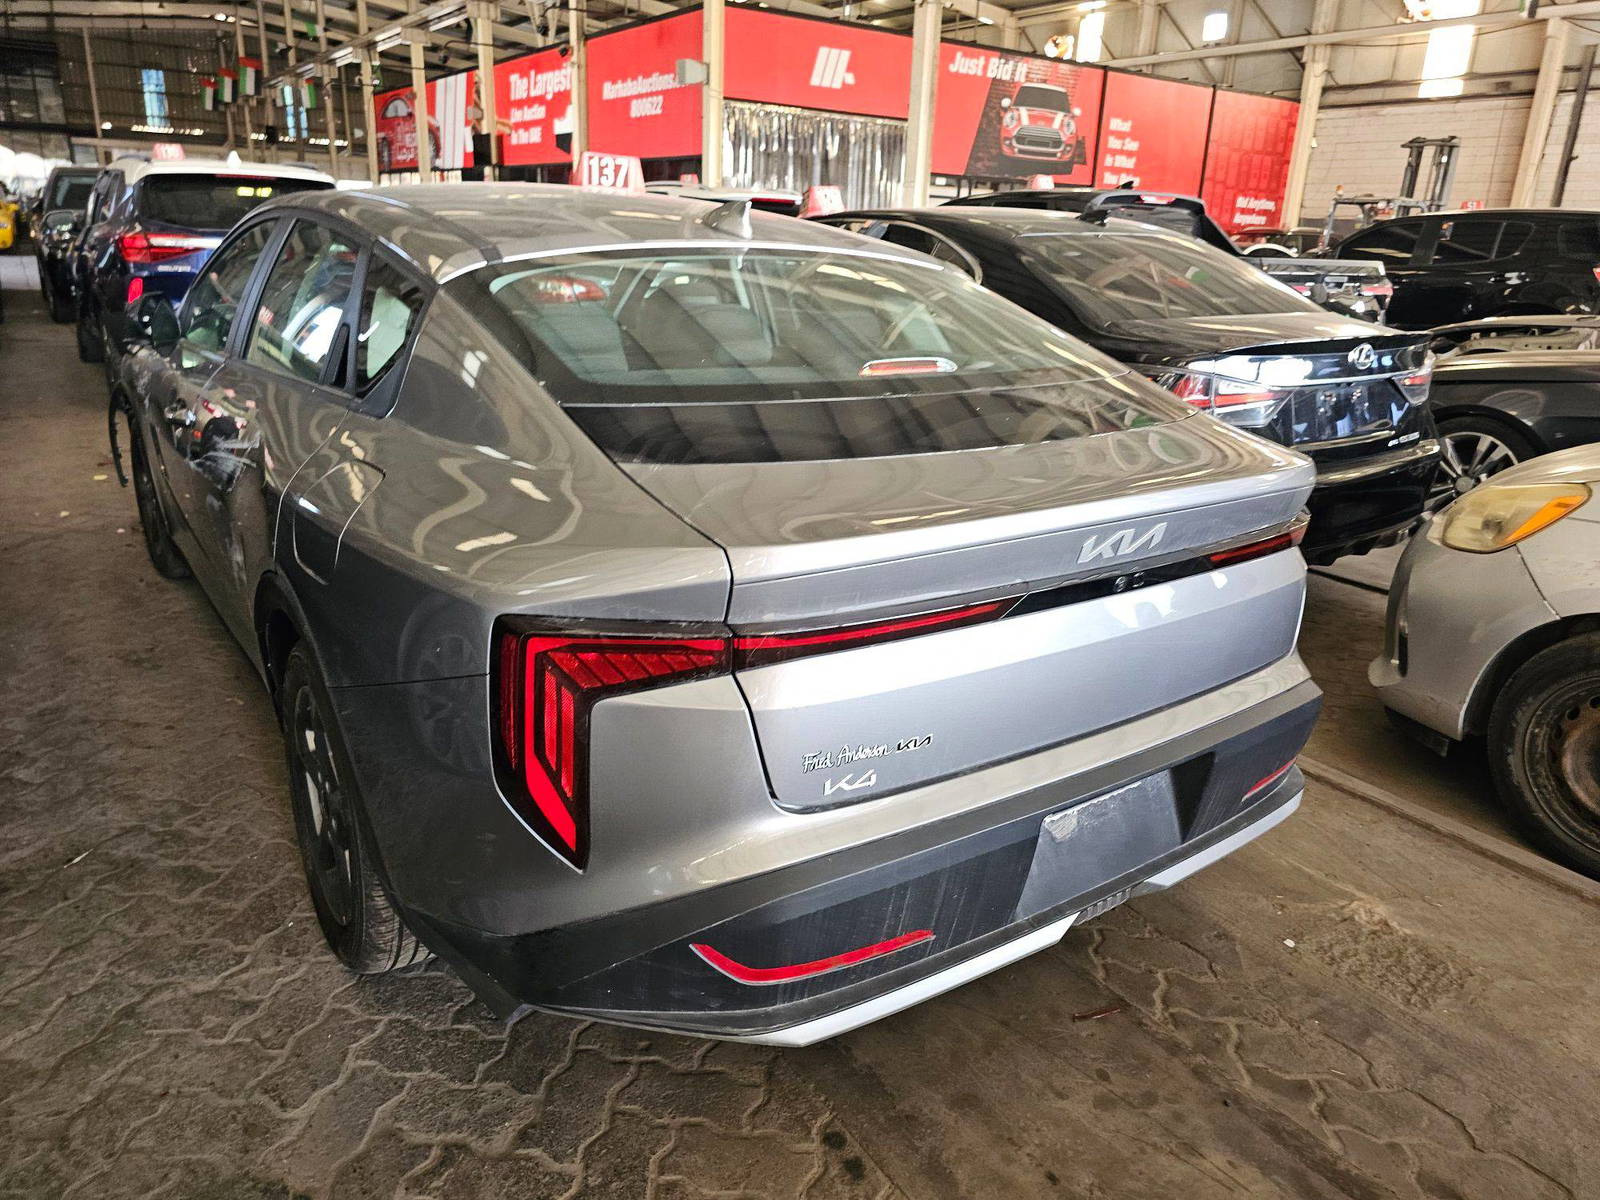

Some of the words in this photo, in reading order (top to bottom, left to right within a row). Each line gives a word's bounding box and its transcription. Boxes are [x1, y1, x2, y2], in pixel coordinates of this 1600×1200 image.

[949, 51, 986, 77] Just
[986, 56, 1014, 81] Bid
[1014, 61, 1028, 82] It
[510, 72, 528, 101] The
[529, 68, 571, 100] Largest
[1109, 117, 1132, 132] What
[590, 155, 629, 188] 137
[1076, 522, 1168, 564] KIA
[802, 750, 834, 773] Fred
[835, 744, 894, 767] Anderson
[895, 733, 934, 754] KIA
[823, 768, 878, 797] K4
